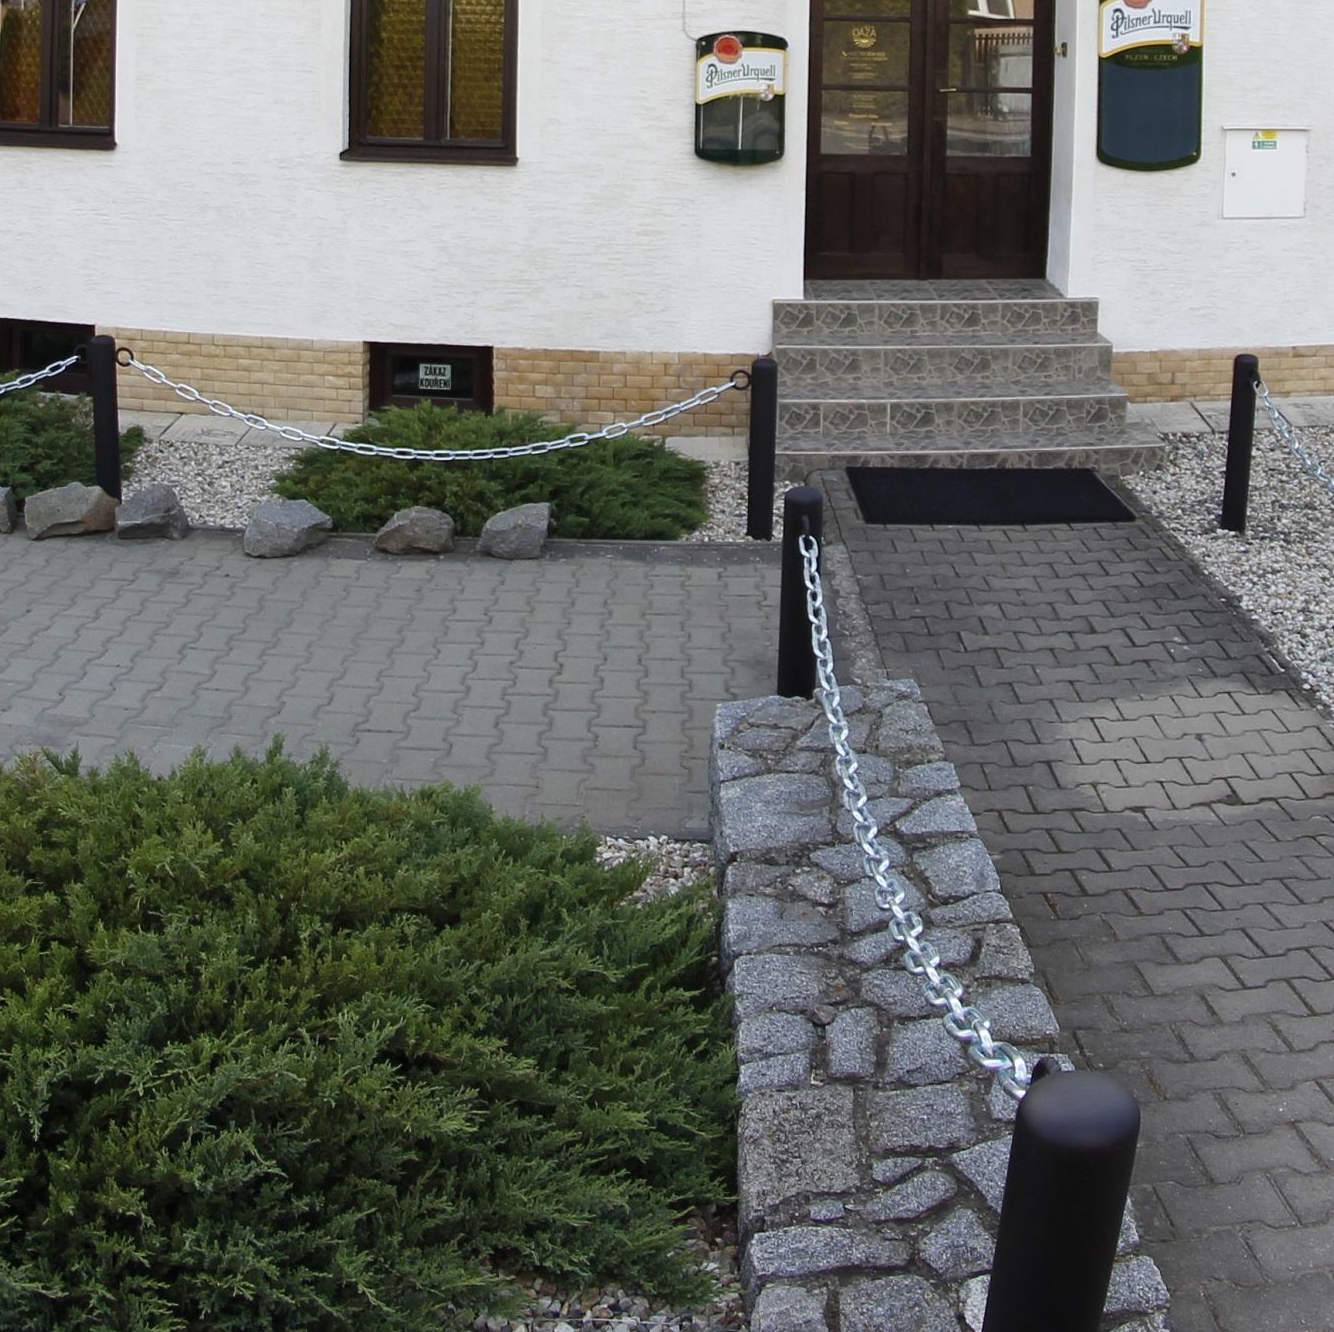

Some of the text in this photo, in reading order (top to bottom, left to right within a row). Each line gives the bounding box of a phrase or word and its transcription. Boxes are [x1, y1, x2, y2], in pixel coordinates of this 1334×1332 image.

[1111, 8, 1192, 39] Pilsner Urquell
[706, 63, 776, 89] Pilsner Urquell
